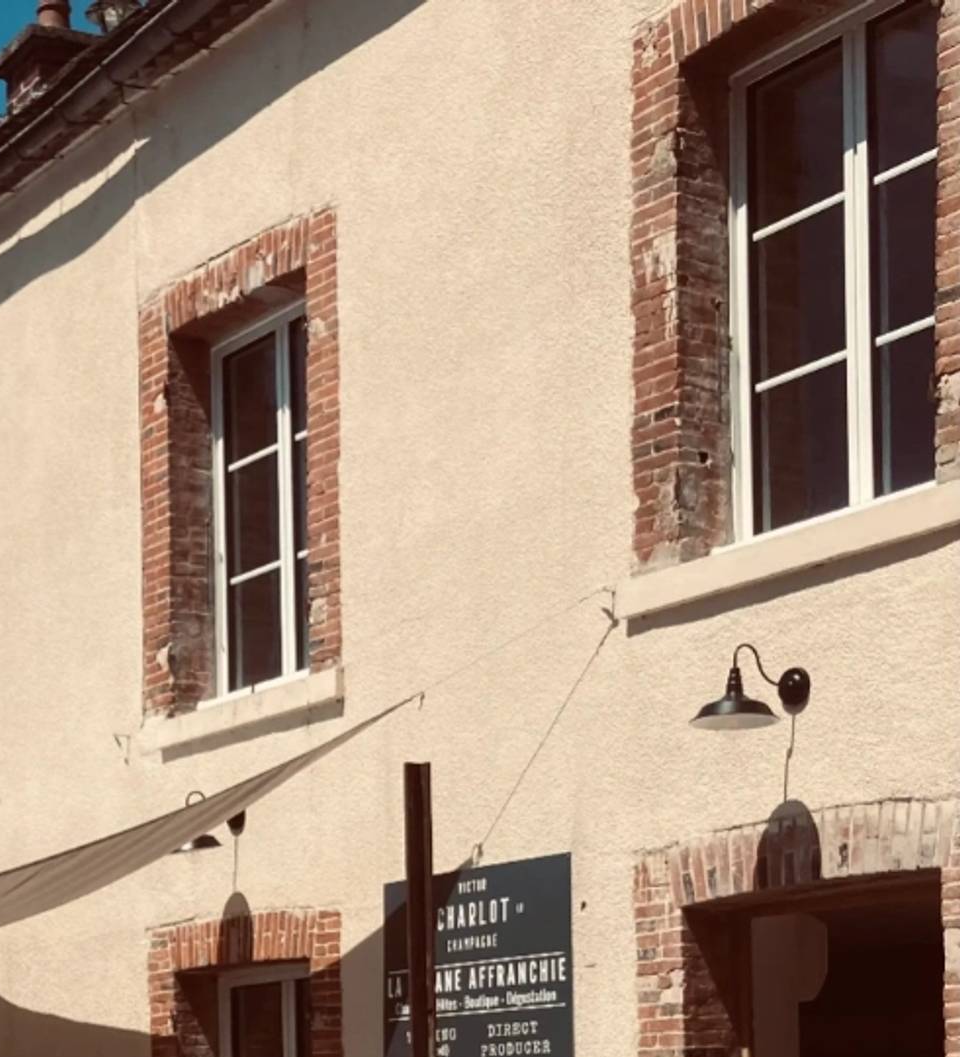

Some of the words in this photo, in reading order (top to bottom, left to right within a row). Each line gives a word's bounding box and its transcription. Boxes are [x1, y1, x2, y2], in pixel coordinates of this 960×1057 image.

[458, 878, 488, 894] VICTOR
[437, 896, 510, 932] CHARLOT
[447, 932, 499, 953] CHAMPAGNE
[387, 976, 402, 998] LA
[434, 968, 462, 994] ANE
[468, 956, 567, 990] AFFRANCHIE
[464, 993, 500, 1010] Boutique
[506, 988, 557, 1007] Dégustation
[487, 1020, 539, 1039] DIRECT
